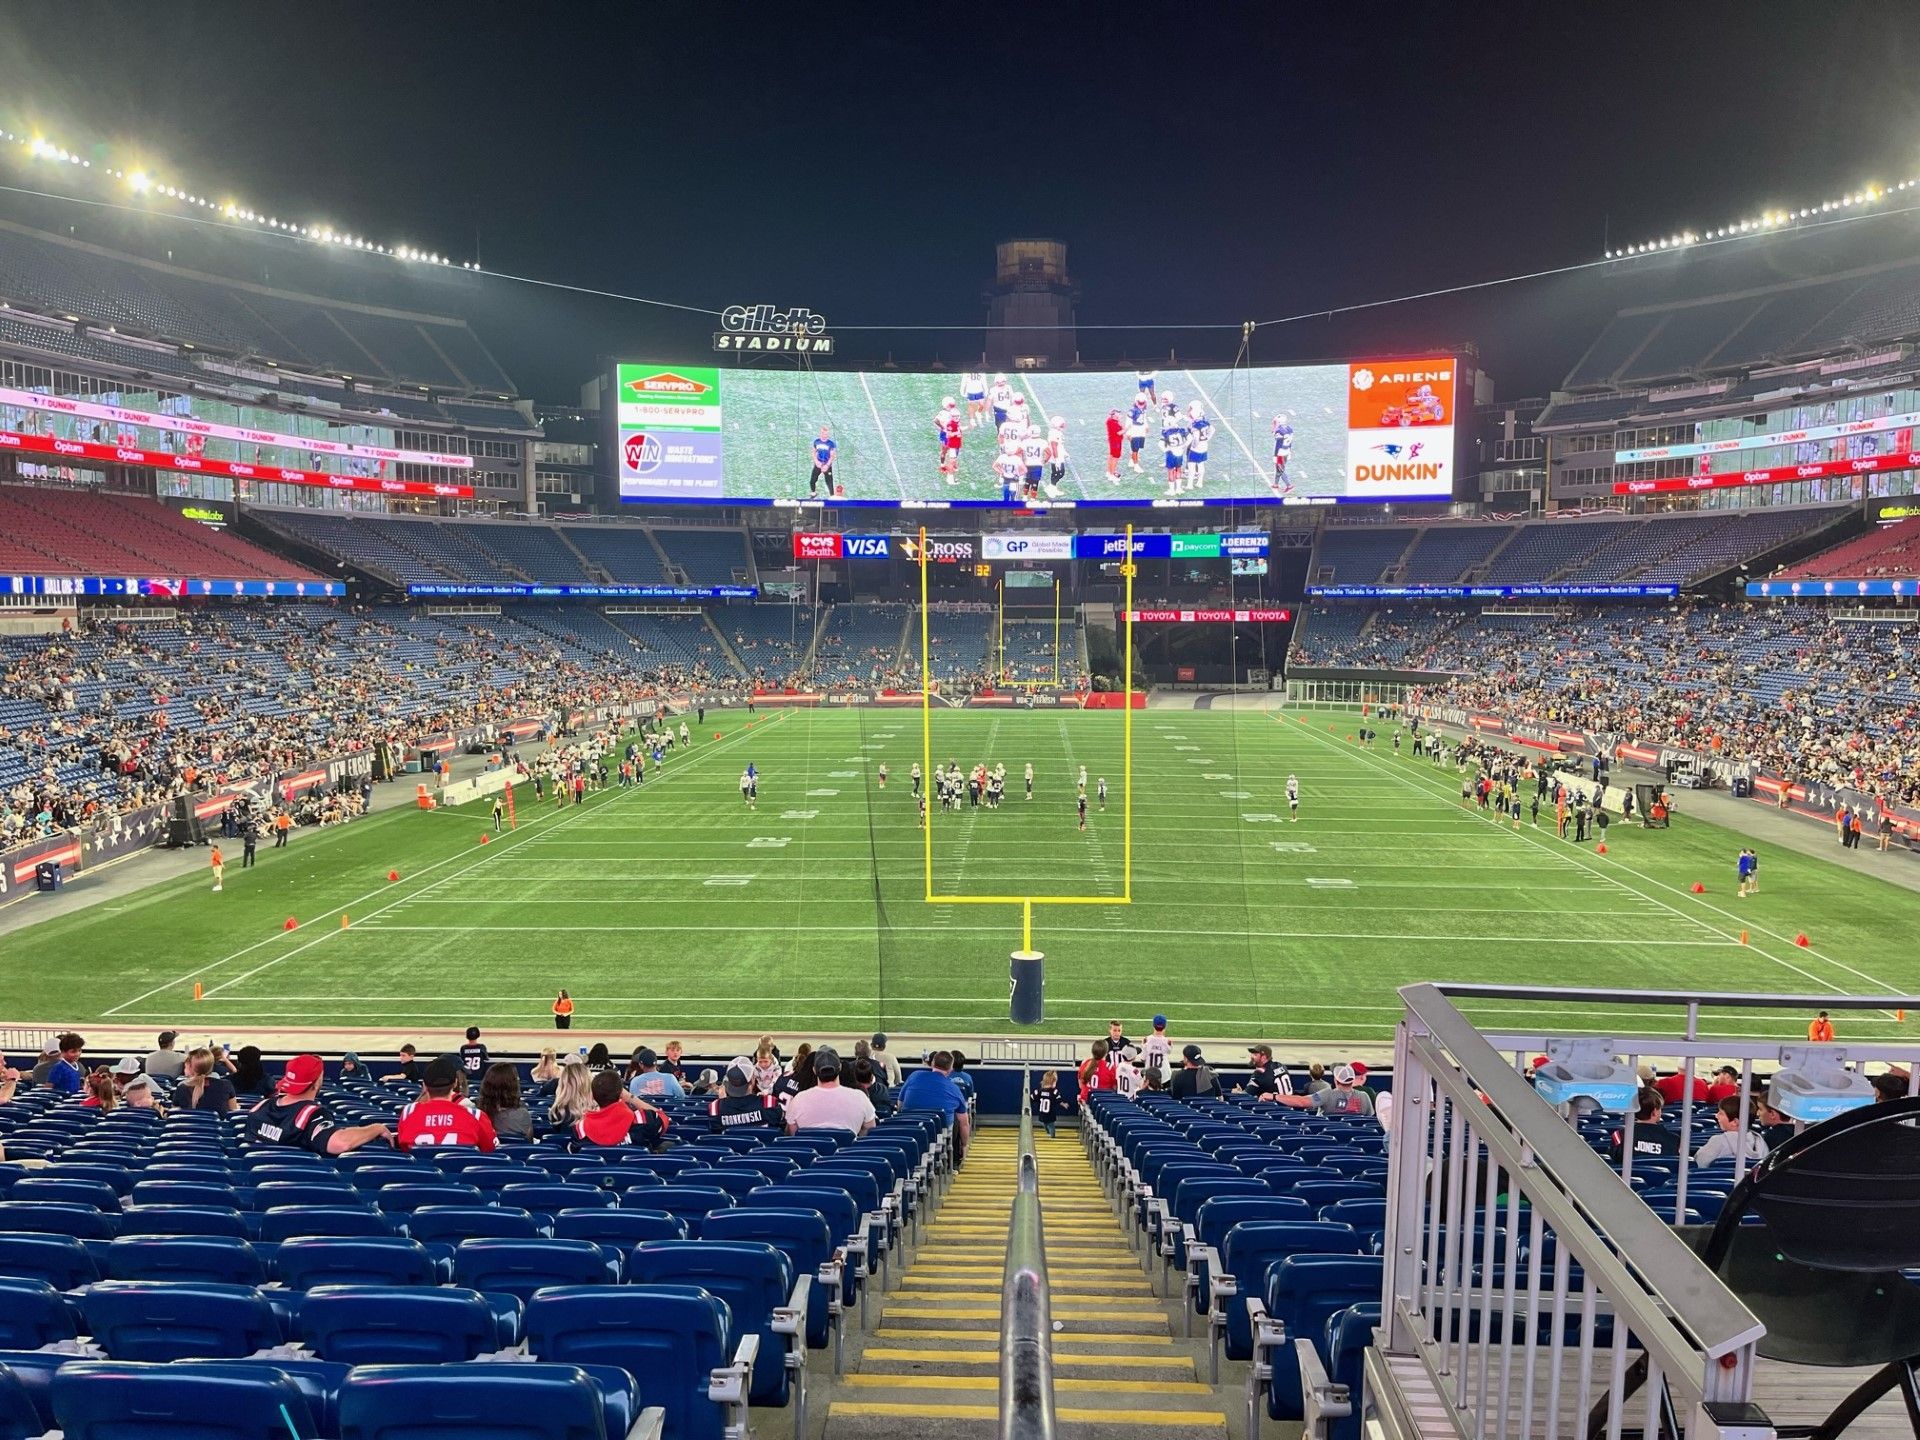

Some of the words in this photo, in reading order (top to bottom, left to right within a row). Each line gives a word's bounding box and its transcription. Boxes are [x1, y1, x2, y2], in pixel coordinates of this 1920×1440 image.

[721, 304, 826, 335] Gillette
[718, 335, 830, 351] STADIUM
[1379, 371, 1453, 384] ARIENS
[54, 440, 84, 454] Optum
[626, 444, 660, 461] WIN
[1026, 446, 1041, 458] 54
[116, 449, 145, 462] Optum
[174, 456, 202, 469] Optum
[229, 463, 254, 475] Optum
[1851, 459, 1878, 470] Optum
[280, 469, 305, 481] Optum
[1355, 462, 1444, 481] DUNKIN'
[1743, 471, 1770, 483] Optum
[1797, 466, 1823, 477] Optum
[329, 475, 354, 486] Optum
[381, 480, 406, 491] Optum
[1687, 477, 1713, 488] Optum
[434, 484, 459, 495] Optum
[1628, 482, 1655, 493] Optum
[811, 537, 835, 547] CVS
[843, 539, 888, 555] VISA
[924, 538, 973, 555] CROSS
[1103, 539, 1146, 554] jetBue
[1184, 543, 1218, 552] paycom
[976, 564, 990, 577] 32
[1141, 611, 1176, 620] TOYOTA
[1196, 611, 1231, 620] TOYOTA
[1252, 611, 1286, 620] TOYOTA
[464, 1056, 481, 1071] 38
[1148, 1052, 1164, 1068] 10
[1118, 1075, 1130, 1093] 10
[1273, 1073, 1294, 1096] 10
[1596, 1090, 1628, 1100] LIGHT
[1040, 1098, 1050, 1113] 10
[424, 1114, 454, 1127] REVIS
[721, 1109, 763, 1126] GRONKOWSKI
[1633, 1140, 1662, 1155] JONES
